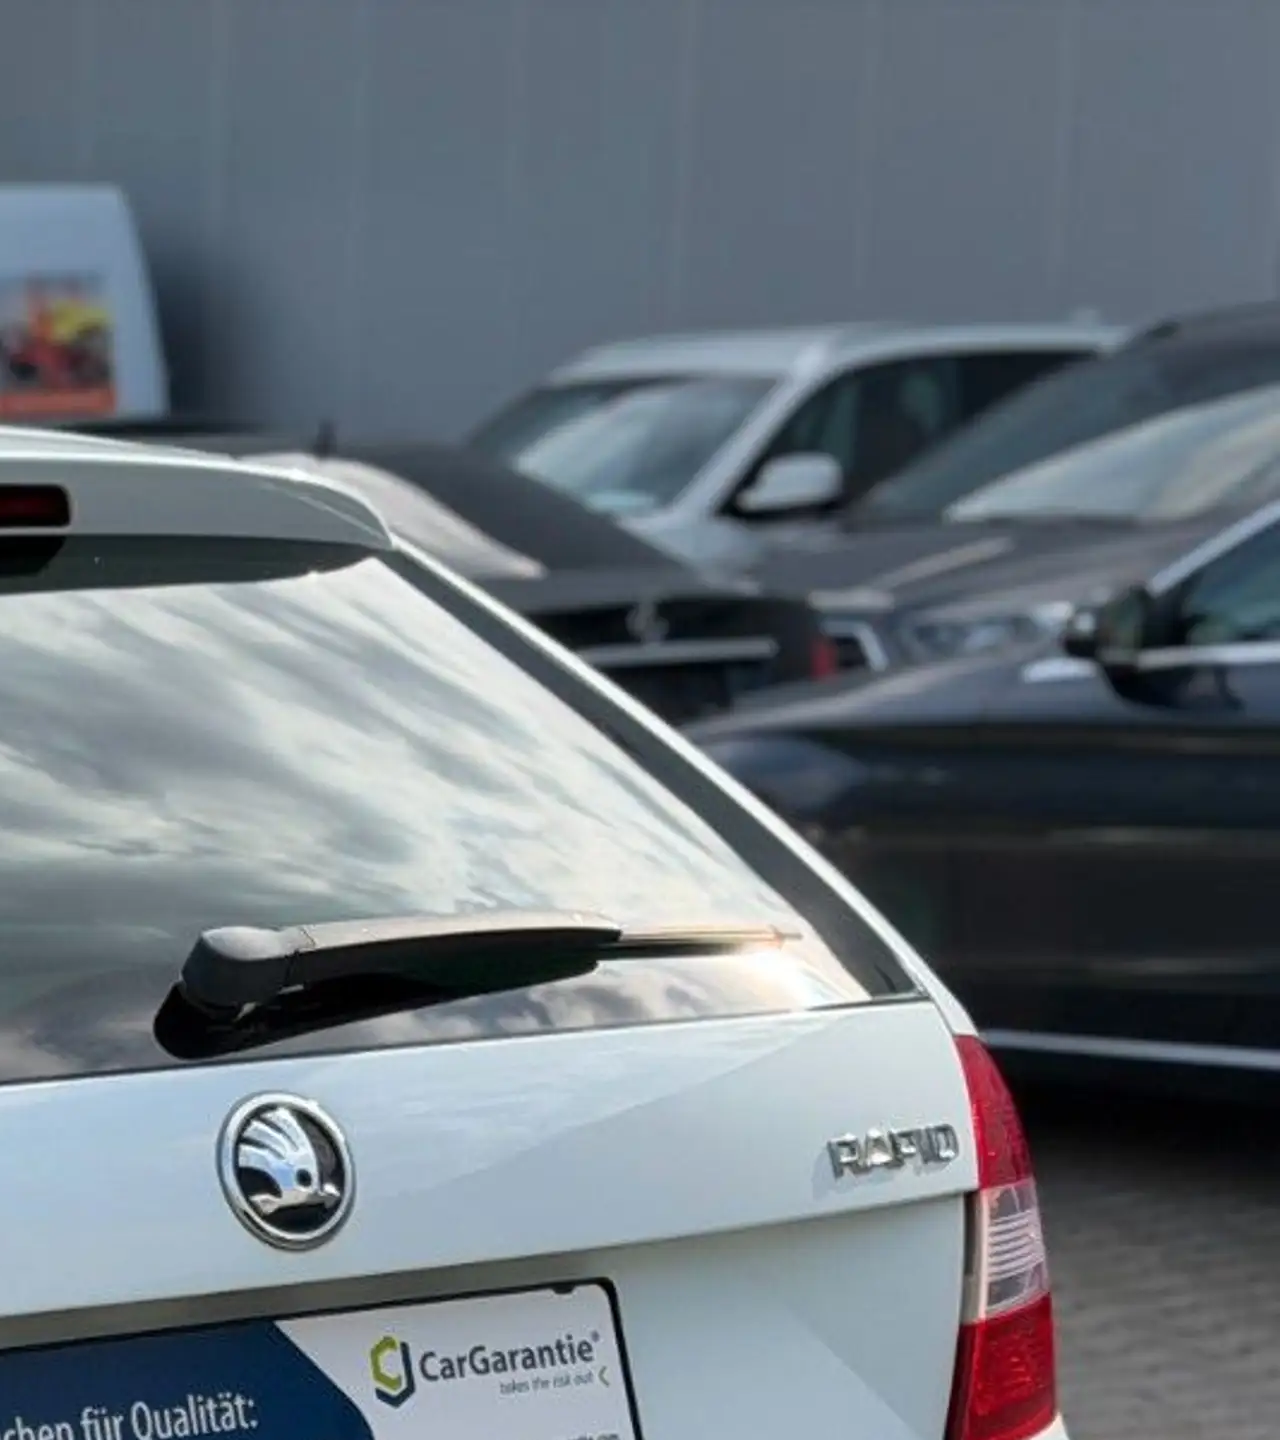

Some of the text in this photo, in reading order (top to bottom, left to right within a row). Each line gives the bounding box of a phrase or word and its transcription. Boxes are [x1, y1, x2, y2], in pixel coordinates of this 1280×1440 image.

[826, 1123, 959, 1179] RAPID
[532, 1375, 549, 1391] the
[552, 1371, 572, 1389] risk
